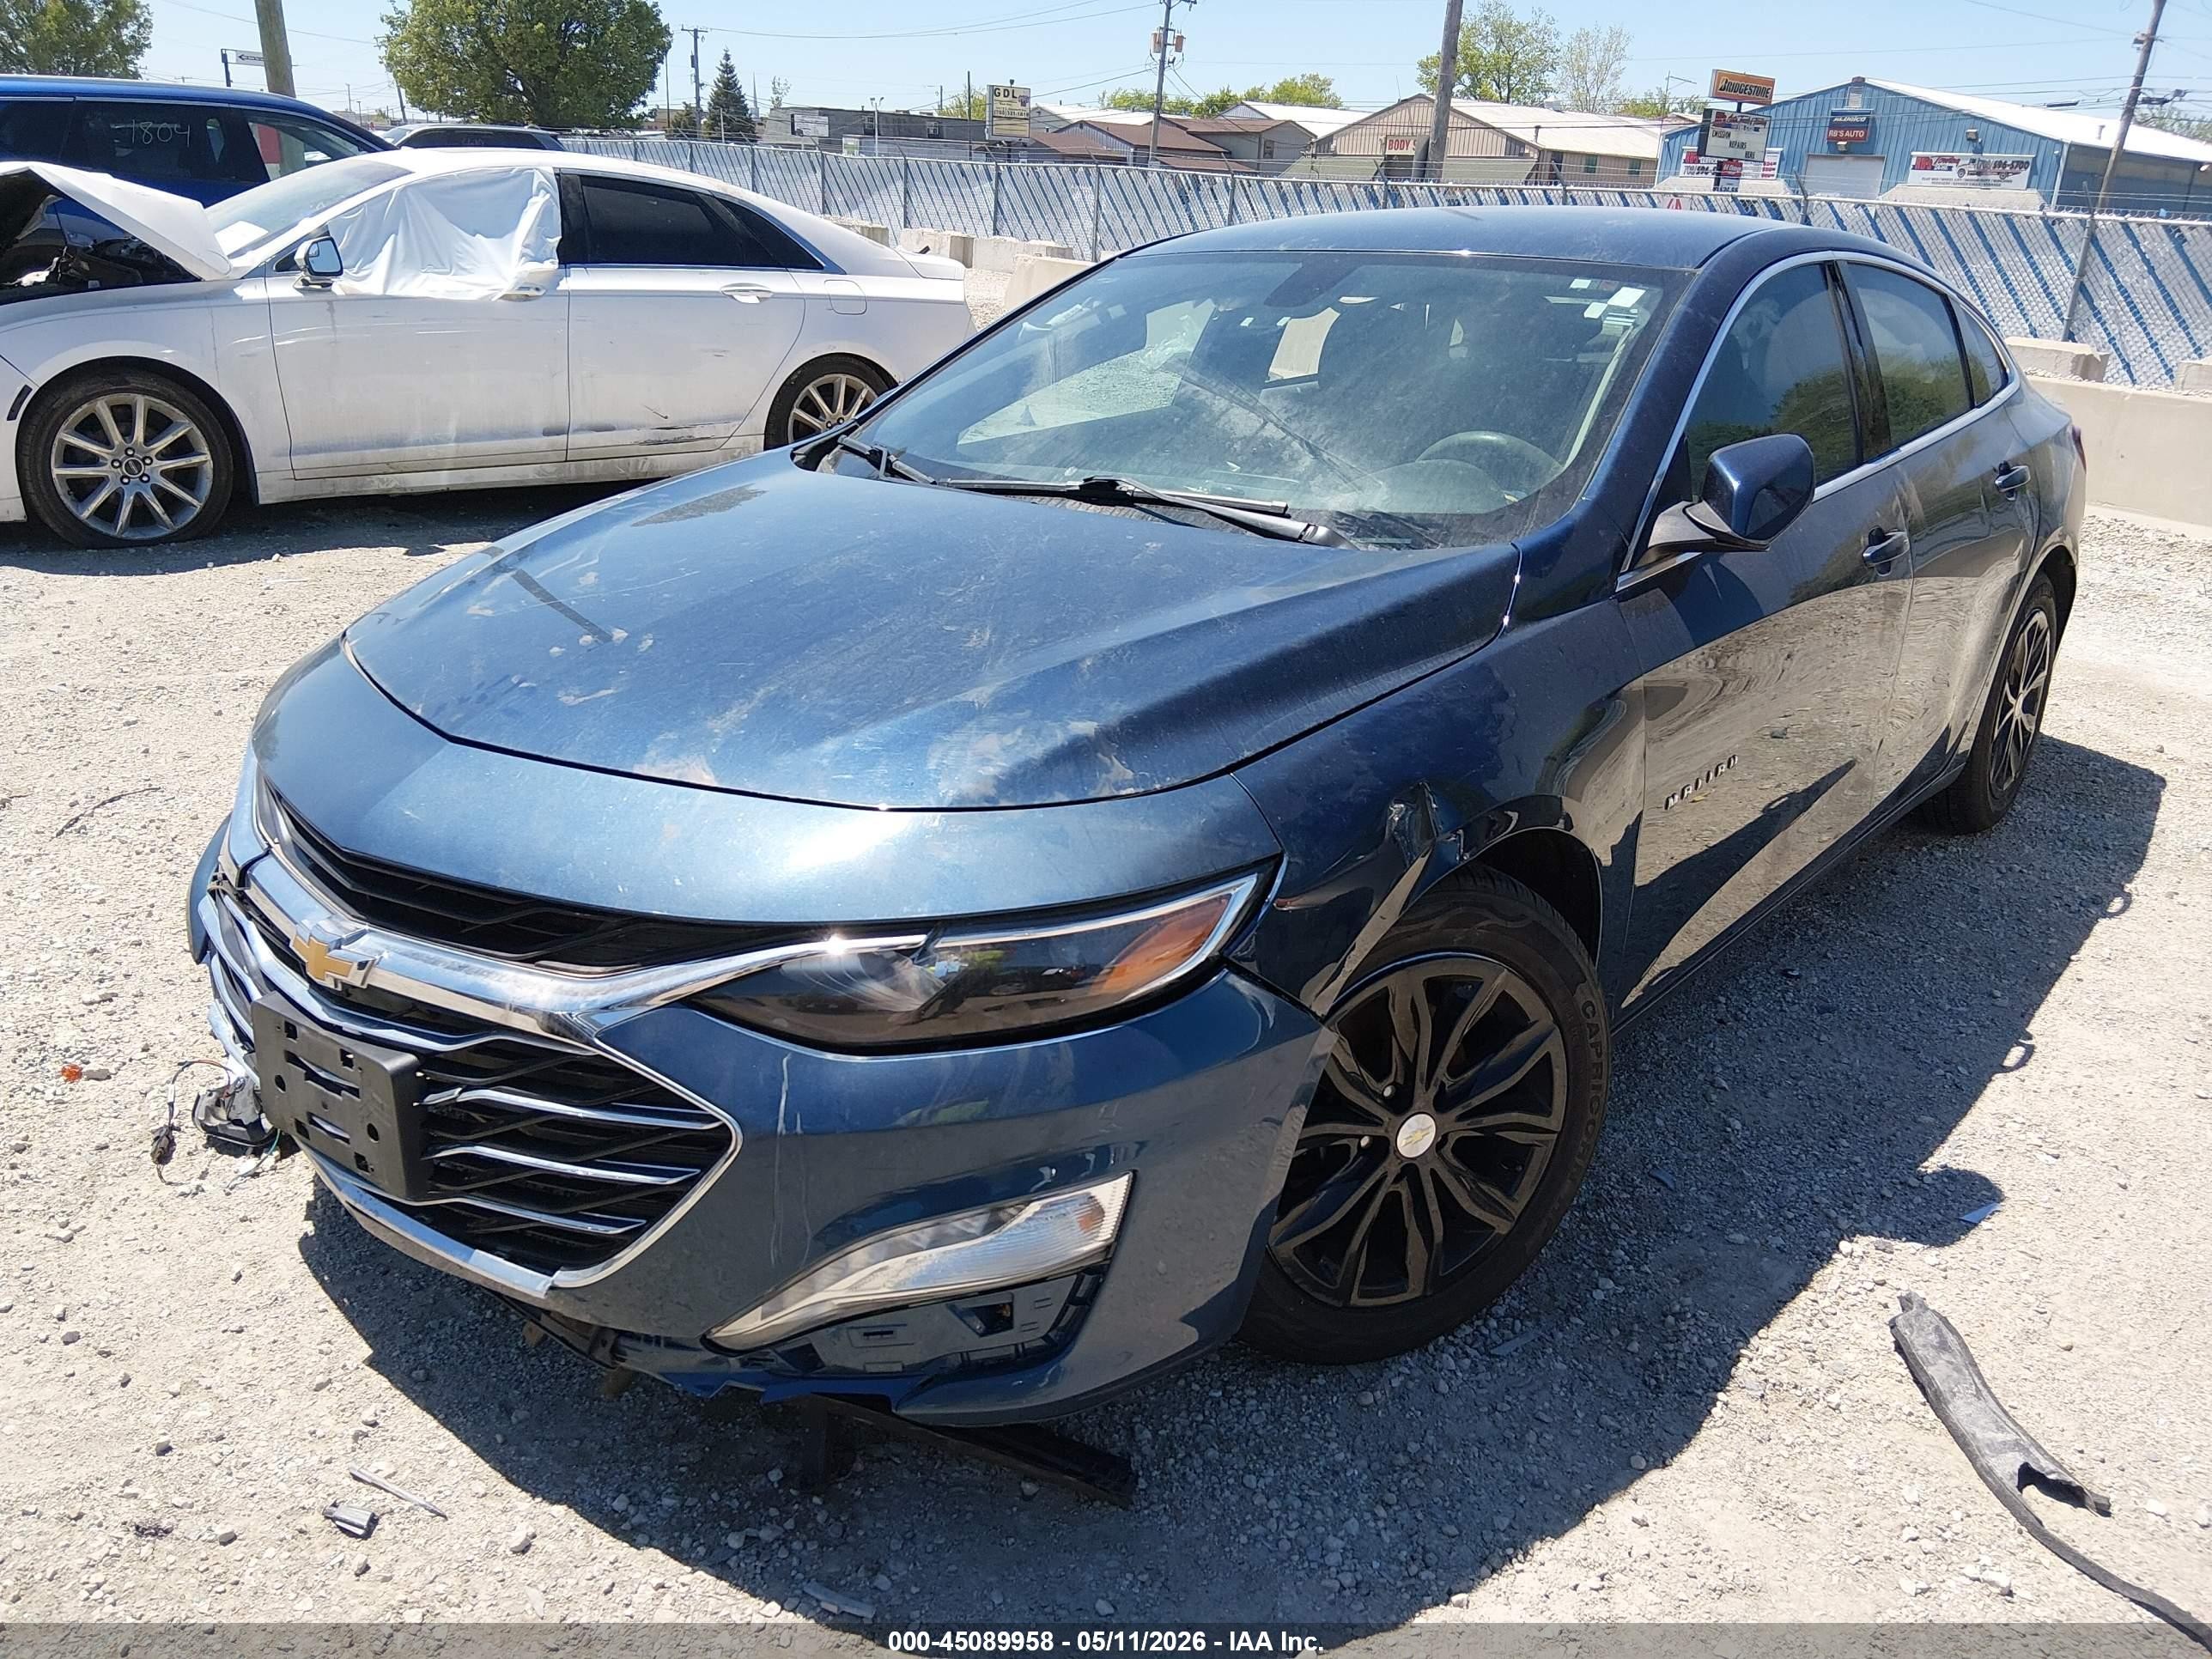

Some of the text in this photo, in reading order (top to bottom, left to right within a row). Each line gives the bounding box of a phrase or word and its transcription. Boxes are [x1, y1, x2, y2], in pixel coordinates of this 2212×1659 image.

[994, 88, 1018, 99] GDL
[1718, 78, 1771, 98] BRIDGESTONE
[131, 119, 191, 148] 1804
[1844, 130, 1865, 138] AUTO
[1388, 138, 1411, 151] BODY
[1729, 140, 1747, 150] REPAIRS
[1664, 755, 1738, 811] MALIBU
